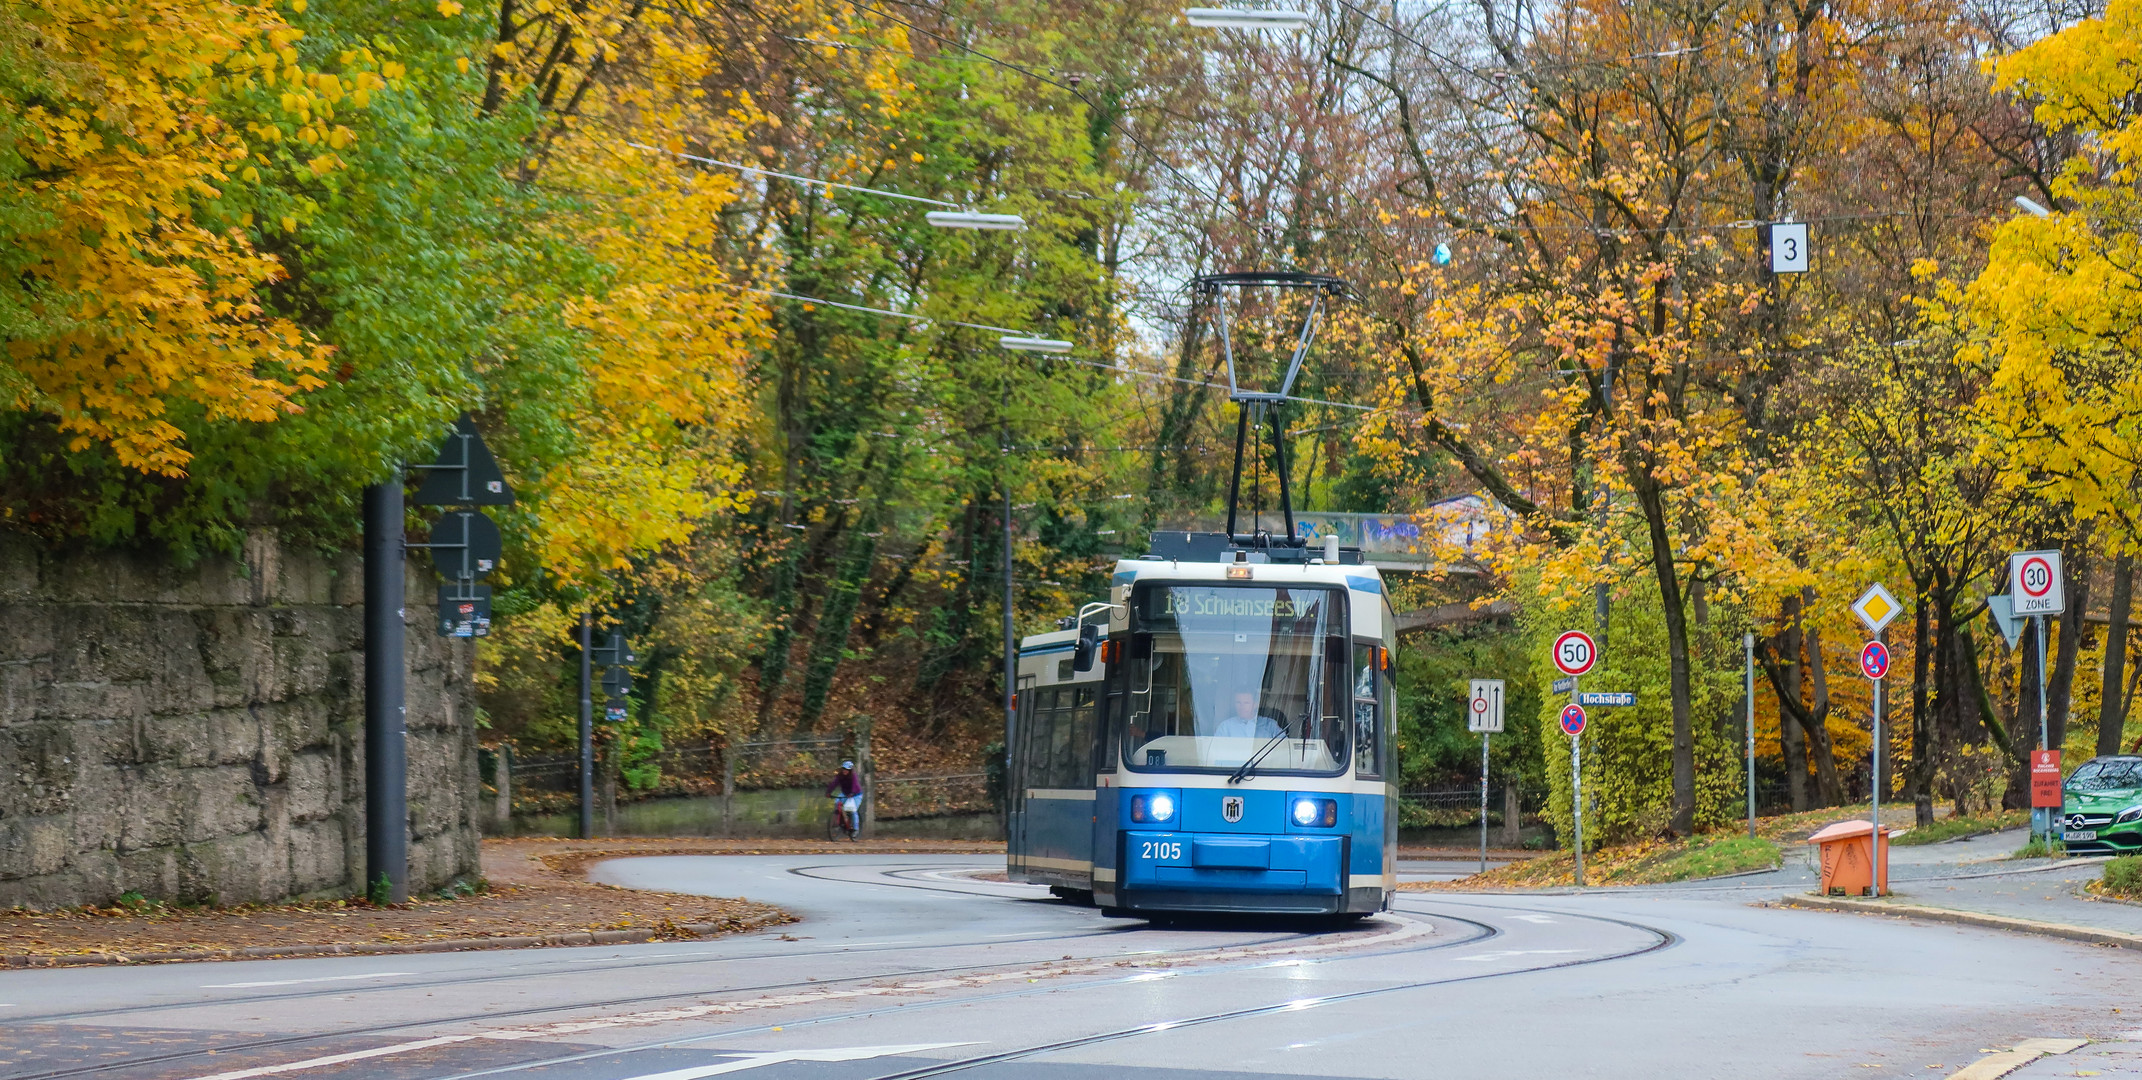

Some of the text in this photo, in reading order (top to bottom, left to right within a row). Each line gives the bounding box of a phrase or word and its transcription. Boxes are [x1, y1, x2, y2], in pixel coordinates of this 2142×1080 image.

[1783, 238, 1798, 261] 3
[2027, 567, 2046, 586] 30
[1164, 592, 1315, 618] 18 Schwanseestr.
[2025, 598, 2051, 610] ZONE
[1563, 644, 1587, 663] 50
[1582, 693, 1632, 706] Hochstraße
[1141, 841, 1182, 860] 2105
